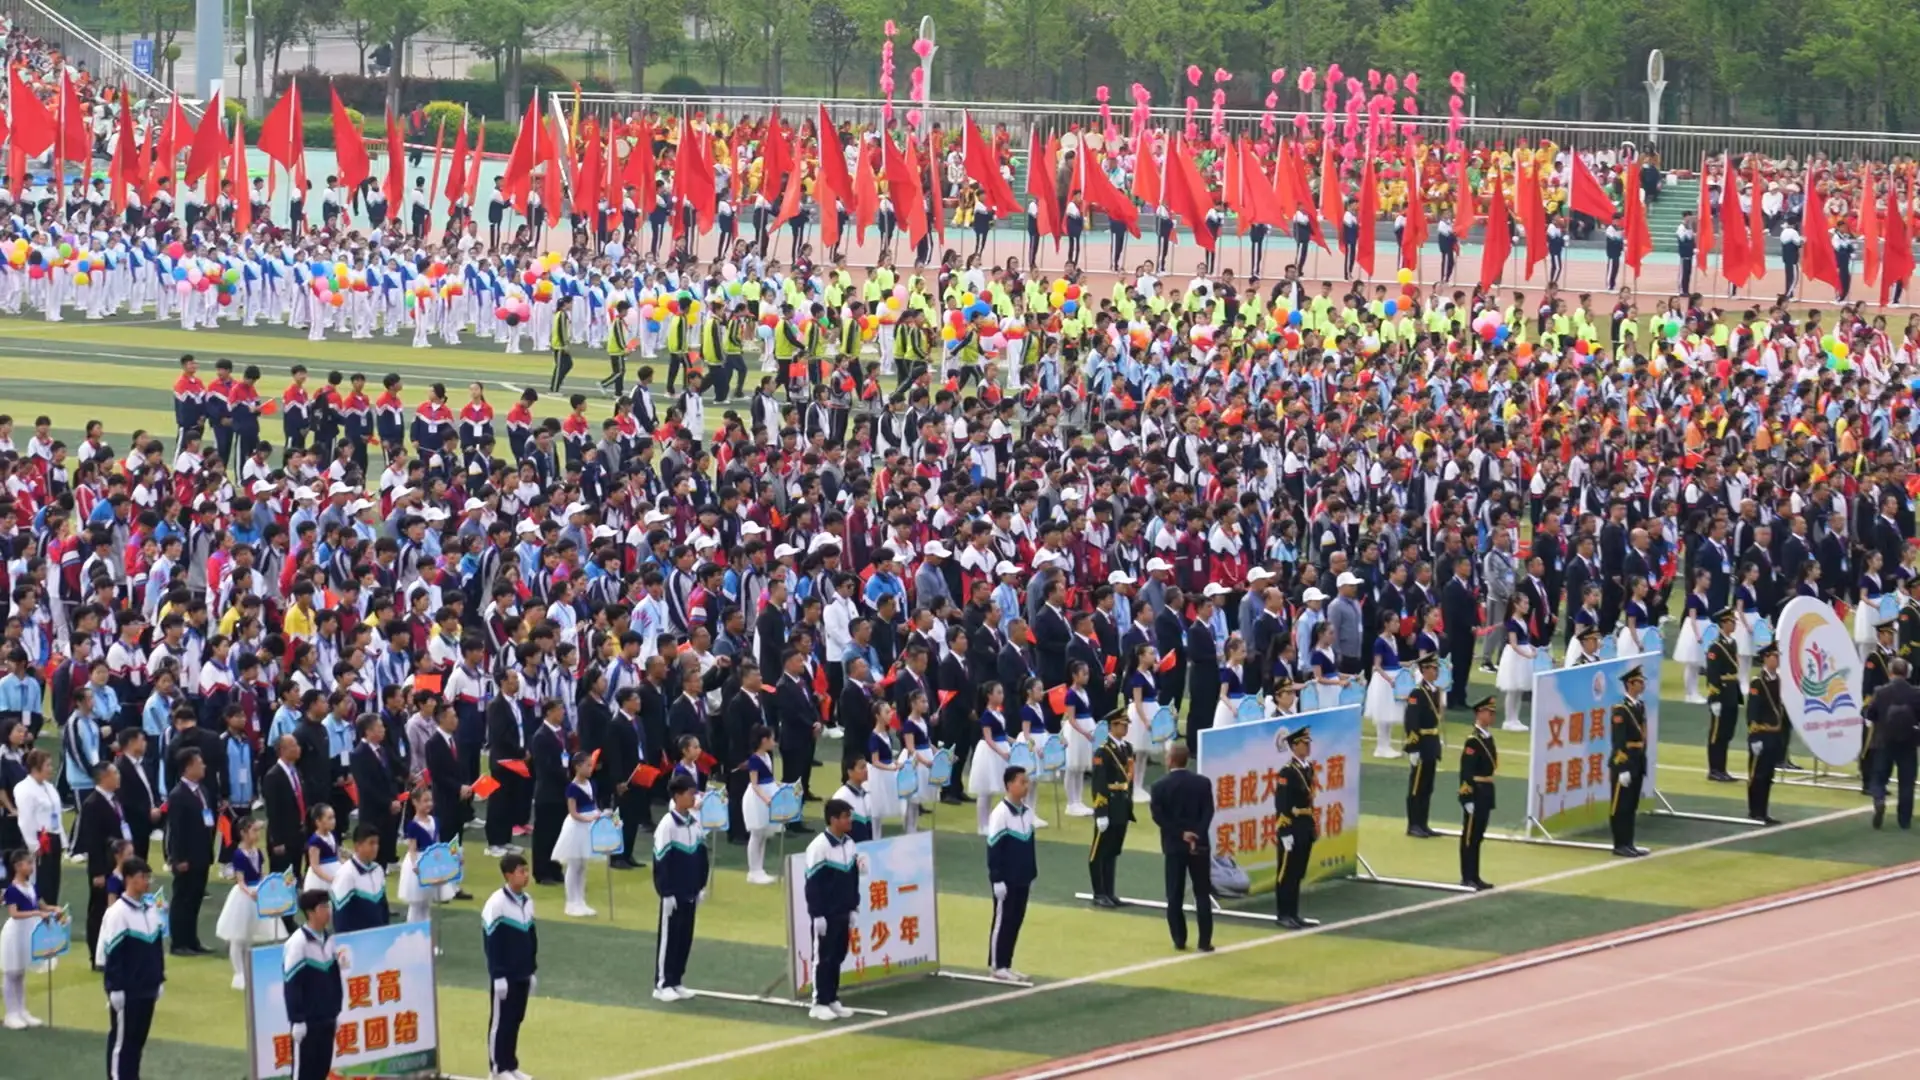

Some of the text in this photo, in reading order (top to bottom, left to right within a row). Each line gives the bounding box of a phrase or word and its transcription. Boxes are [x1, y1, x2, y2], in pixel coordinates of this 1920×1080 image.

[1216, 754, 1346, 810] 建成大大荔
[1216, 801, 1344, 857] 实现共裕
[347, 968, 401, 1010] 更高
[272, 1010, 419, 1069] 更更团结
